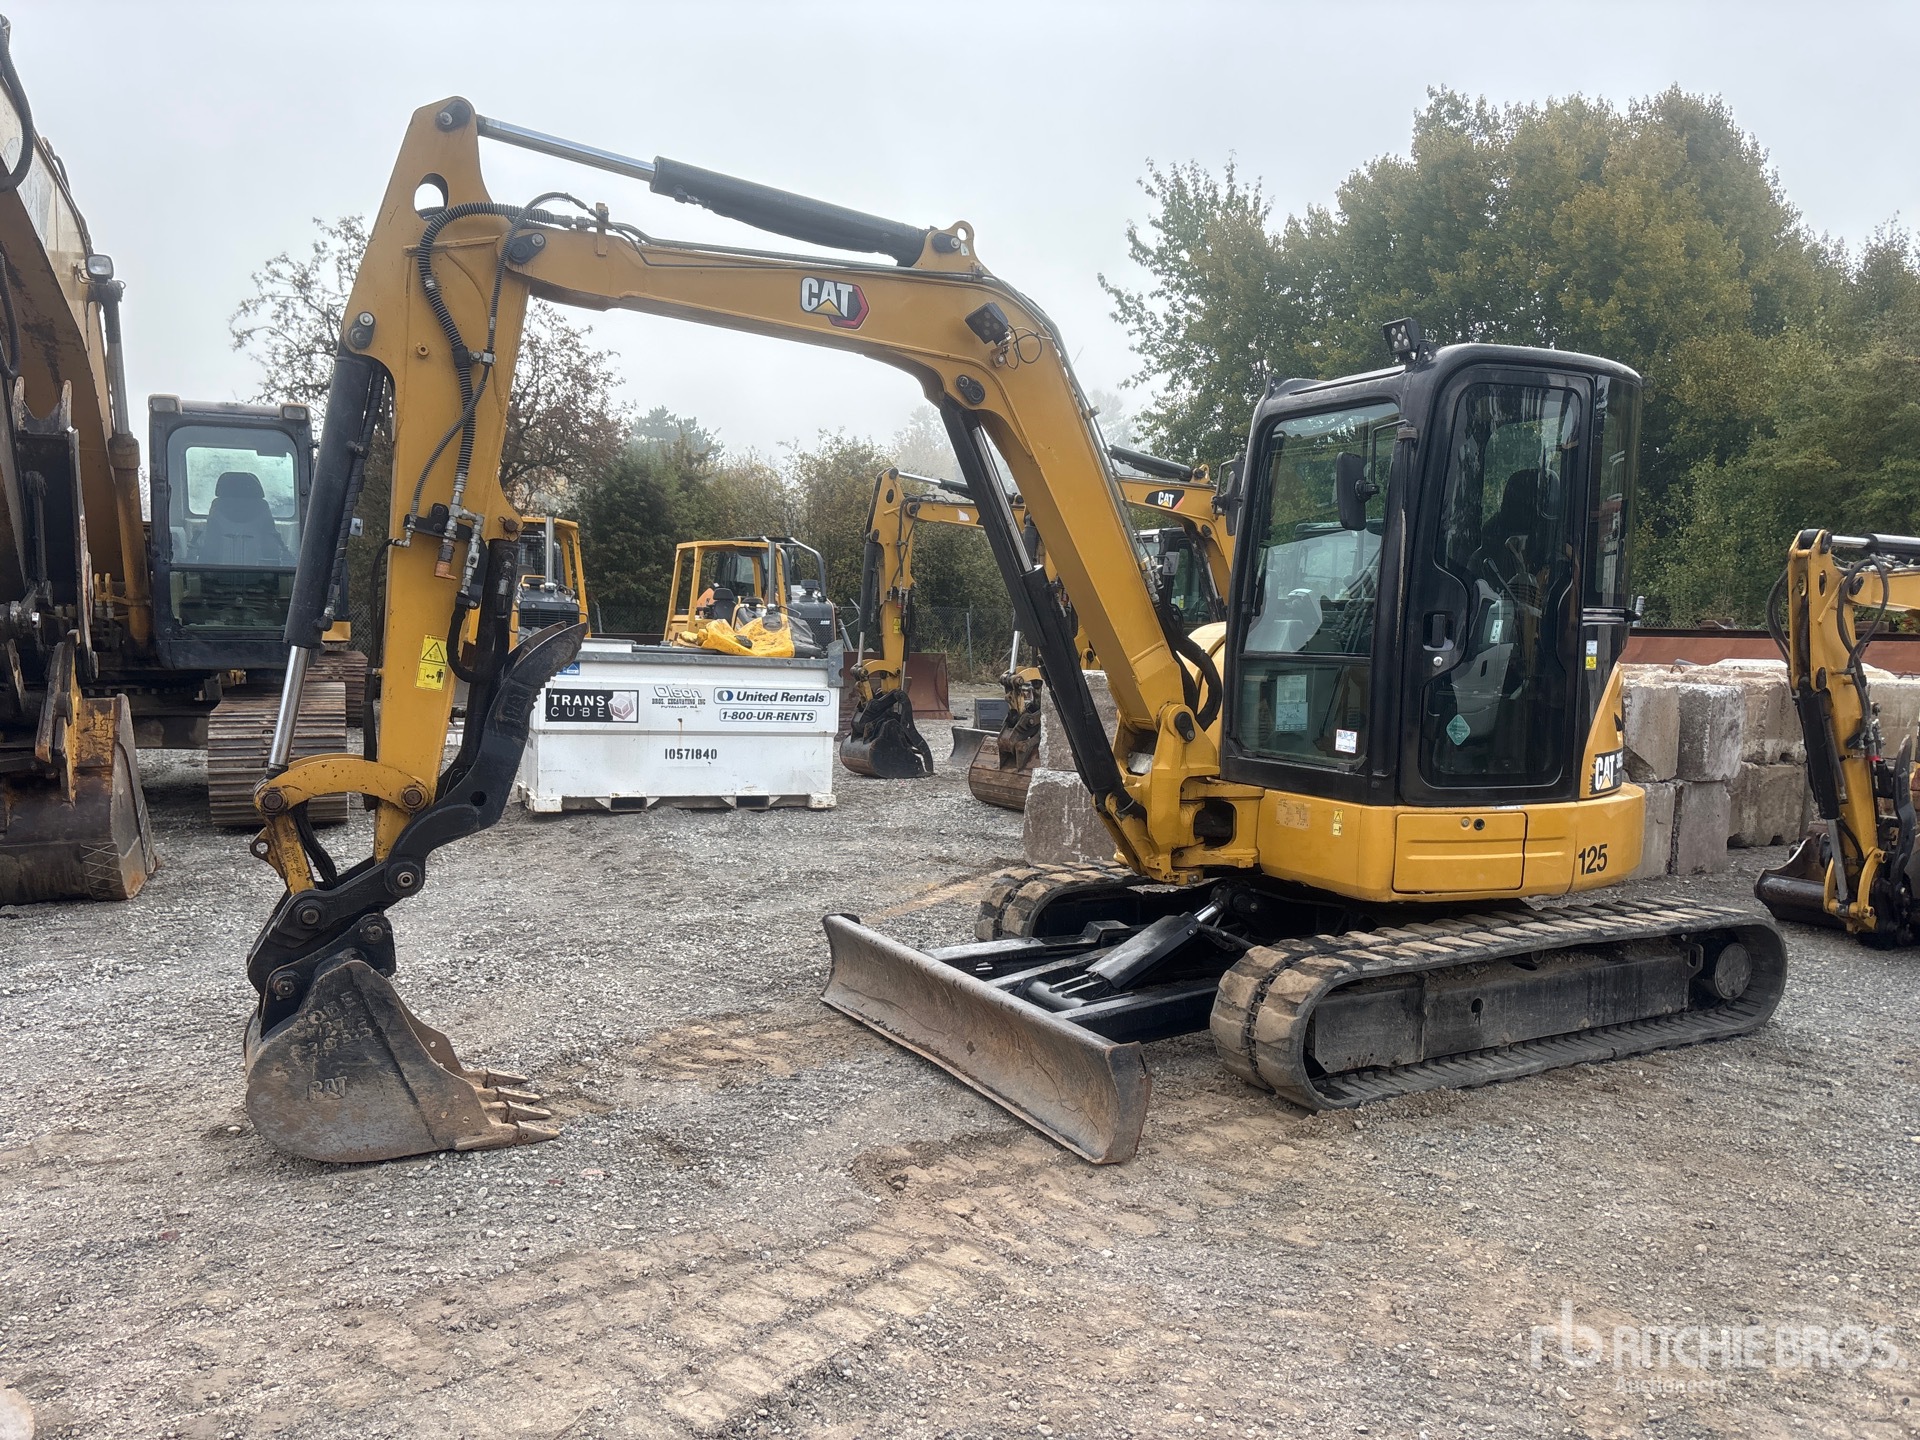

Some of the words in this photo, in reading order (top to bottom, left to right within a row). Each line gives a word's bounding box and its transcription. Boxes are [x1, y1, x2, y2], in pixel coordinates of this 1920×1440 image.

[802, 277, 853, 317] CAT
[1158, 491, 1174, 507] CAT
[653, 685, 702, 698] Olson
[736, 690, 779, 702] United
[781, 692, 825, 703] Rentals
[551, 695, 605, 706] TRANS
[551, 707, 605, 717] CUBE
[722, 711, 814, 721] 1-800-UR-RENTS
[665, 748, 717, 760] 10571840
[1595, 754, 1615, 791] CAT
[1578, 844, 1608, 875] 125
